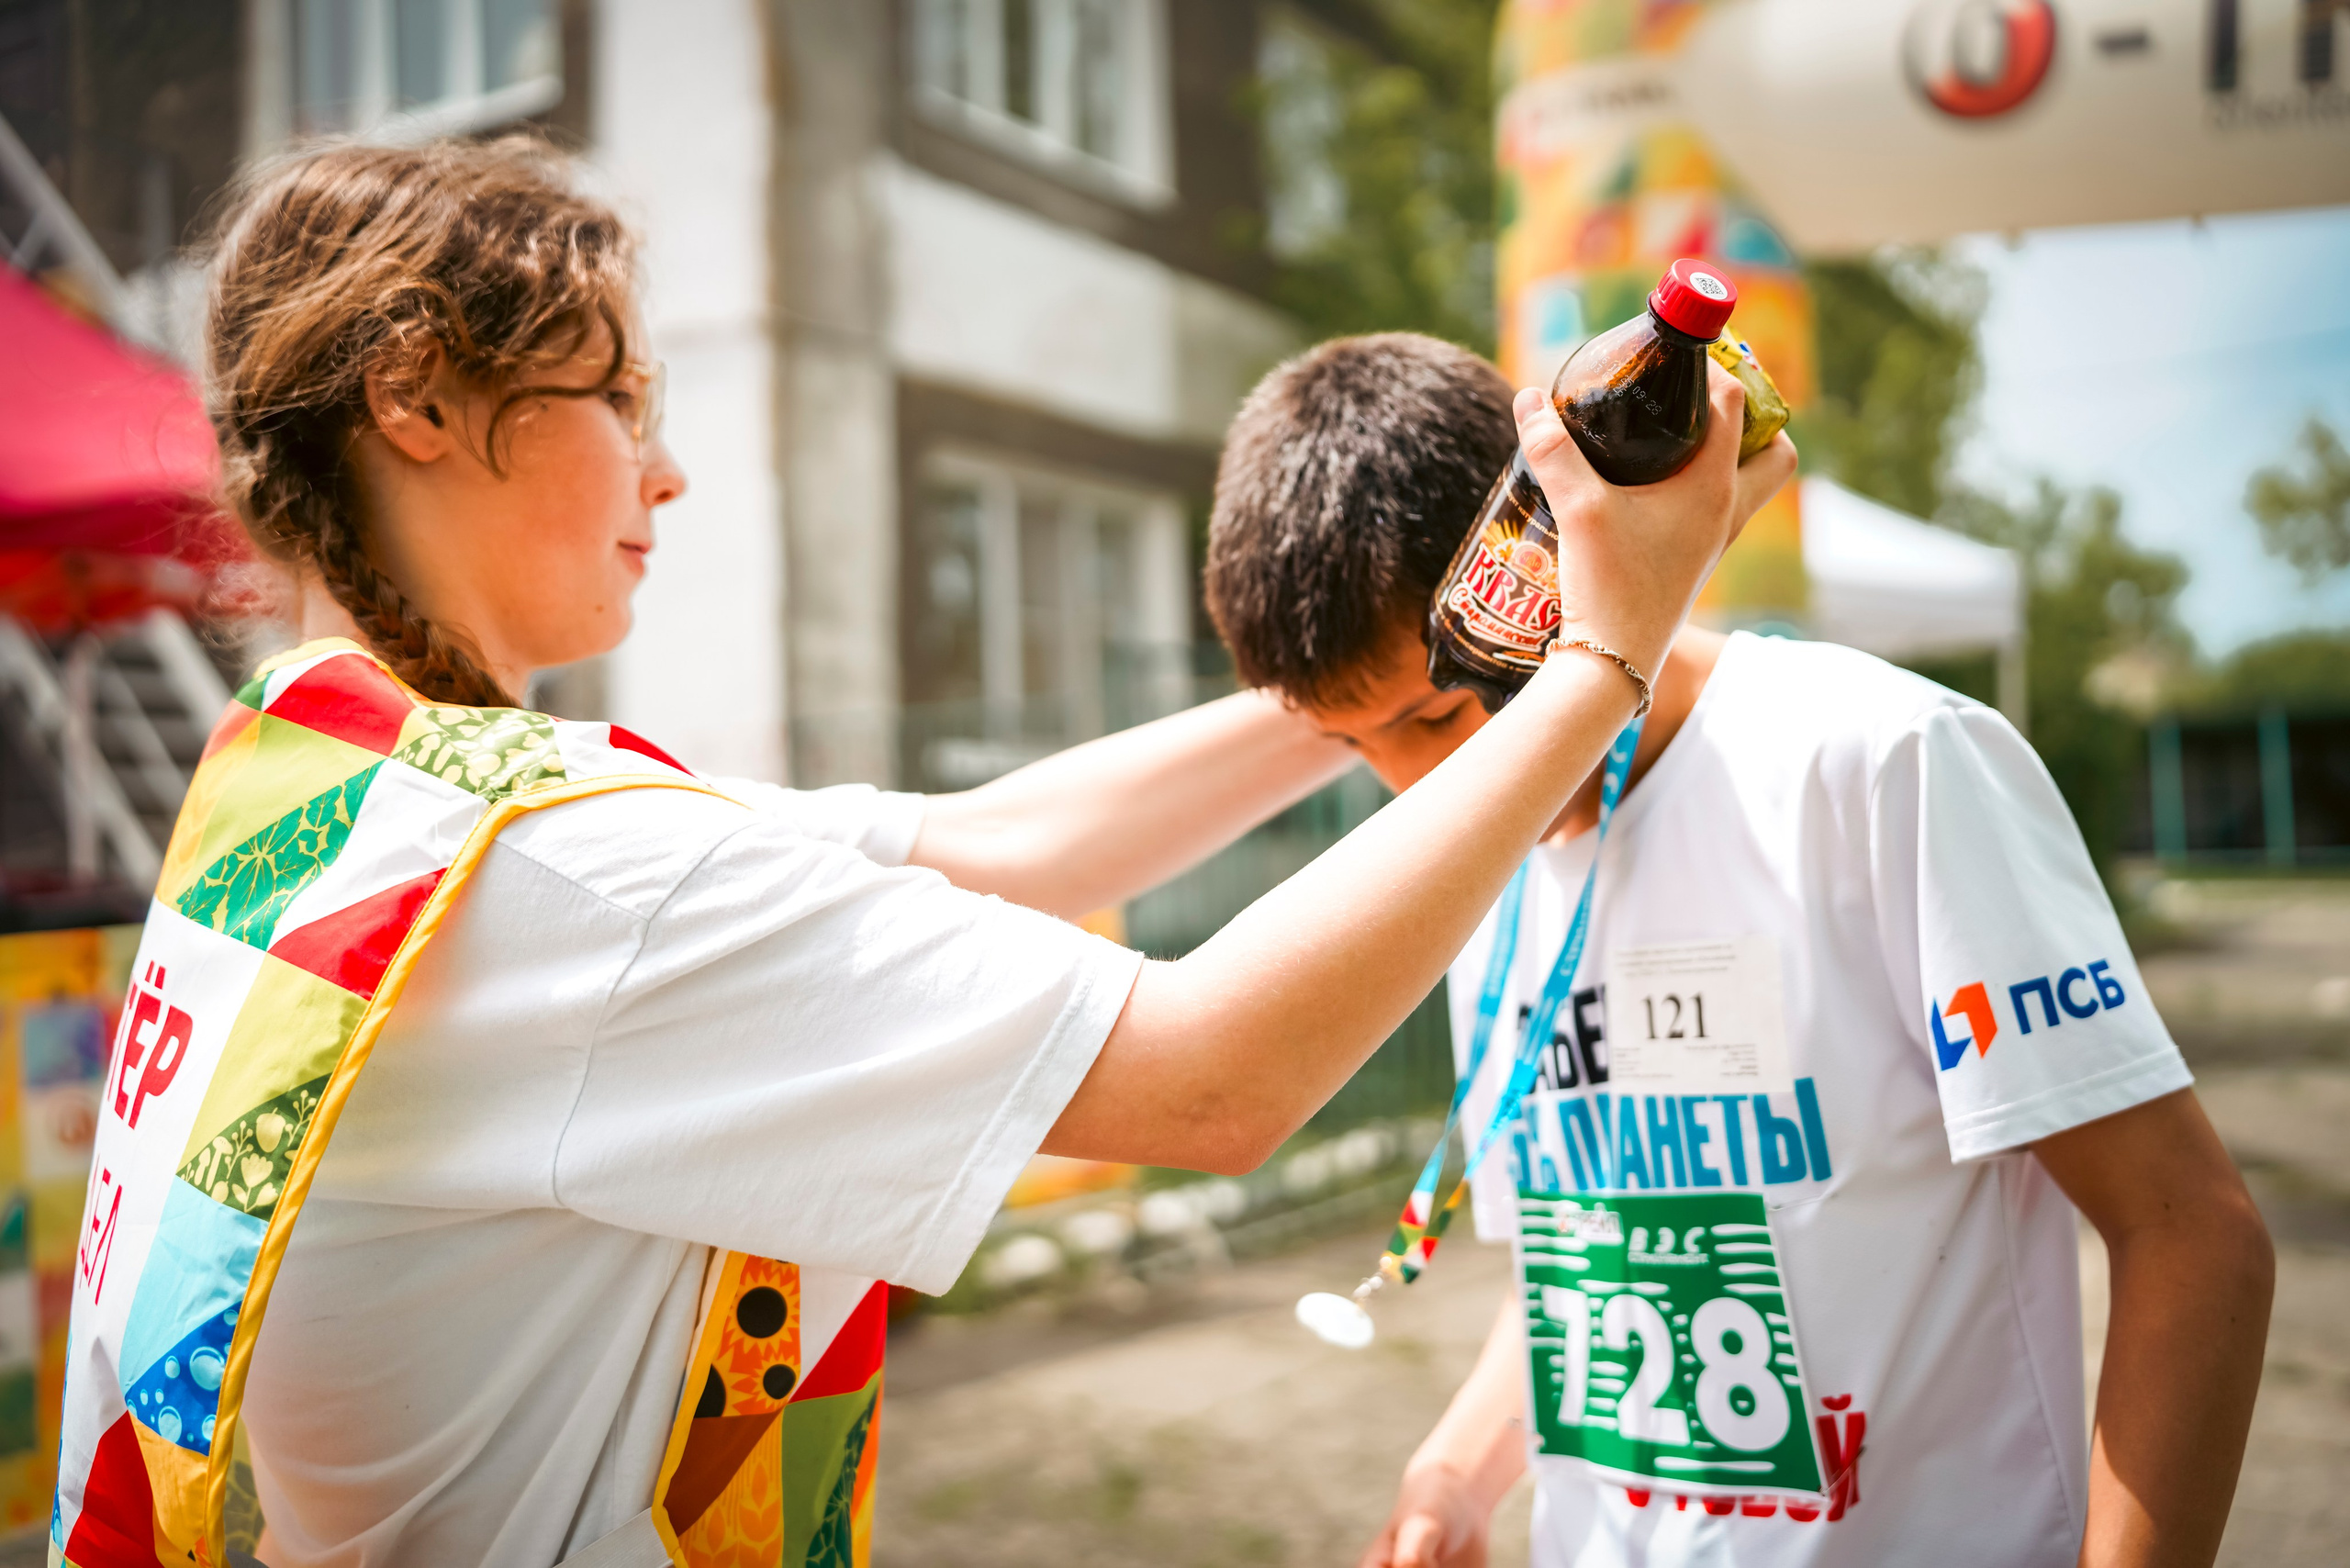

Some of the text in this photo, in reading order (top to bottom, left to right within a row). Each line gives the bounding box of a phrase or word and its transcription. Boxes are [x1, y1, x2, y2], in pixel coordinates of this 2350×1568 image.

[1631, 385, 1662, 416] 09:28
[1639, 991, 1709, 1039] 121
[2008, 958, 2125, 1035] ПСБ
